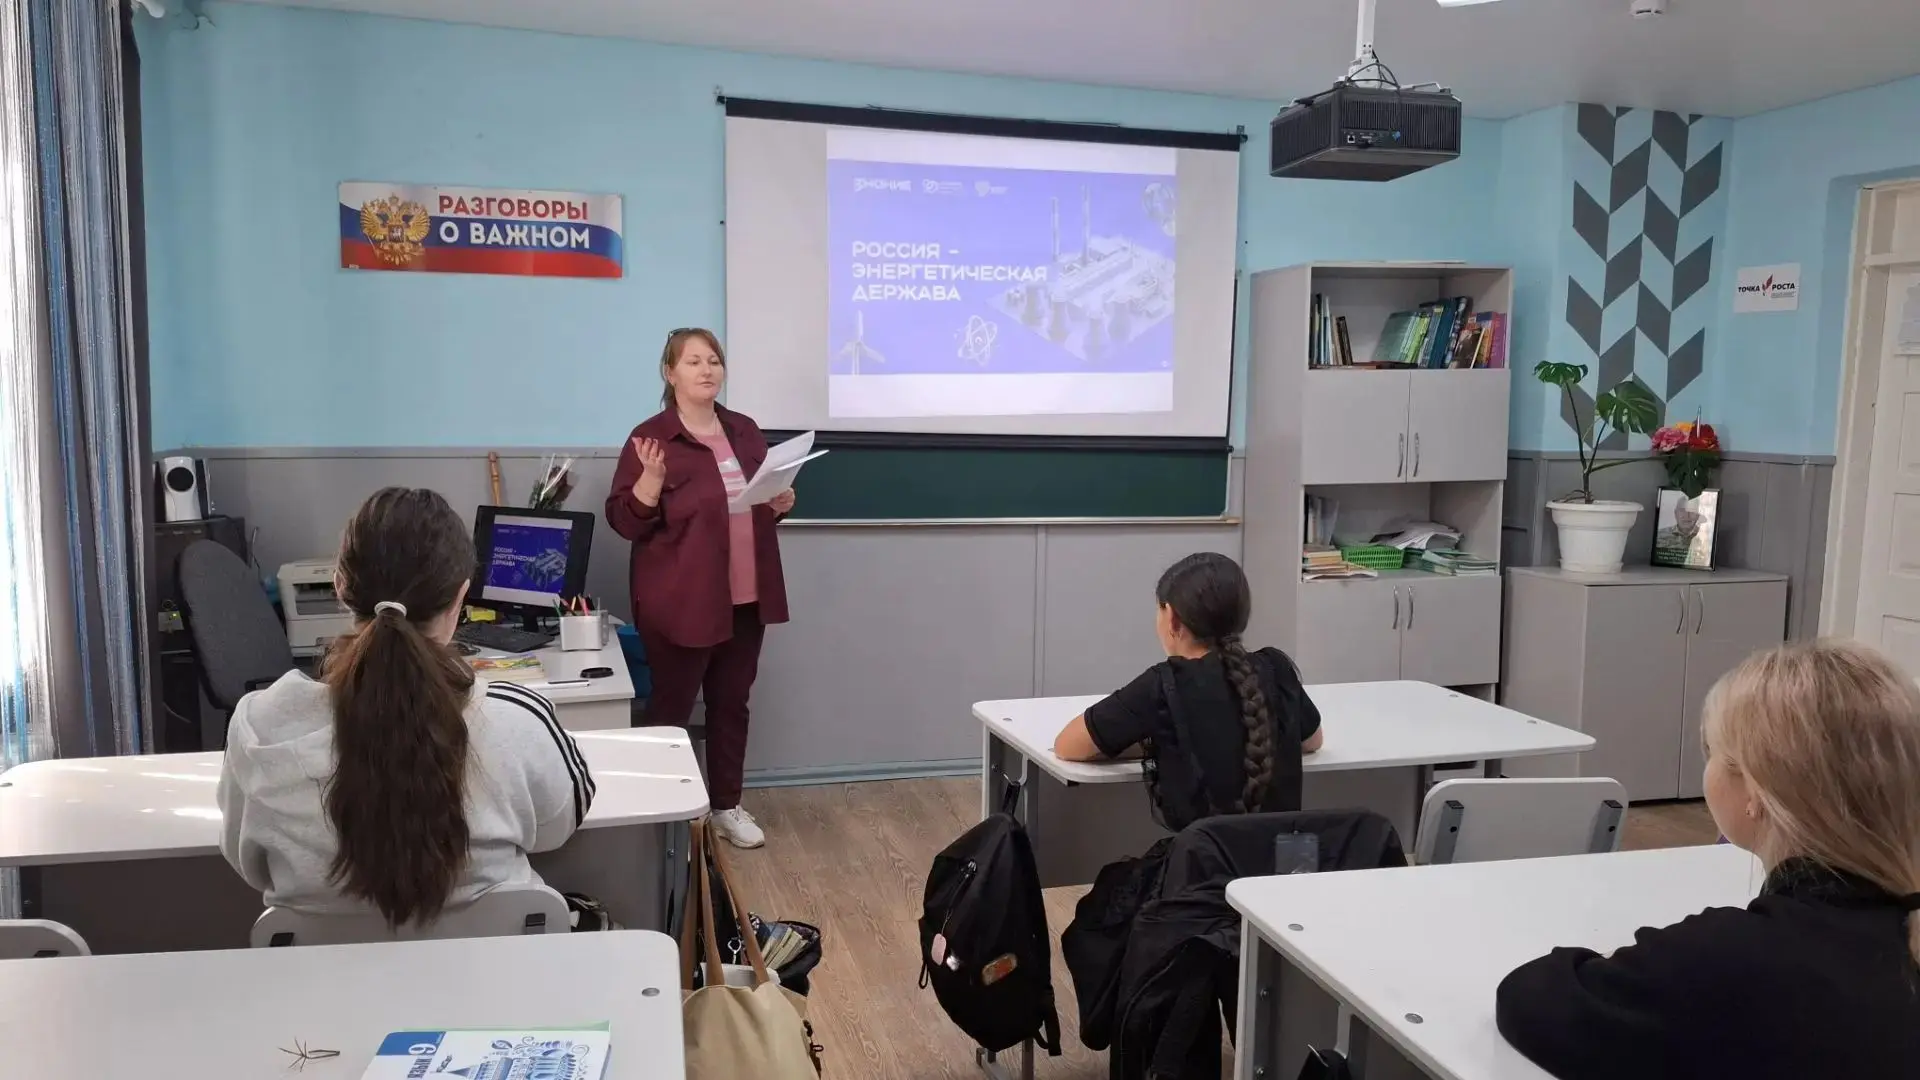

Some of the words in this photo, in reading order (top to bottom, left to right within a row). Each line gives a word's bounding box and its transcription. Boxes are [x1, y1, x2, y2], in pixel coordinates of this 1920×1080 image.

[439, 195, 588, 220] РАЗГОВОРЫ
[439, 221, 459, 243] О
[470, 222, 589, 249] ВАЖНОМ
[852, 241, 940, 259] РОССИЯ
[852, 263, 1047, 281] ЭНЕРГЕТИЧЕСКАЯ
[852, 284, 961, 301] ДЕРЖАВА
[1771, 283, 1795, 291] РОСТА
